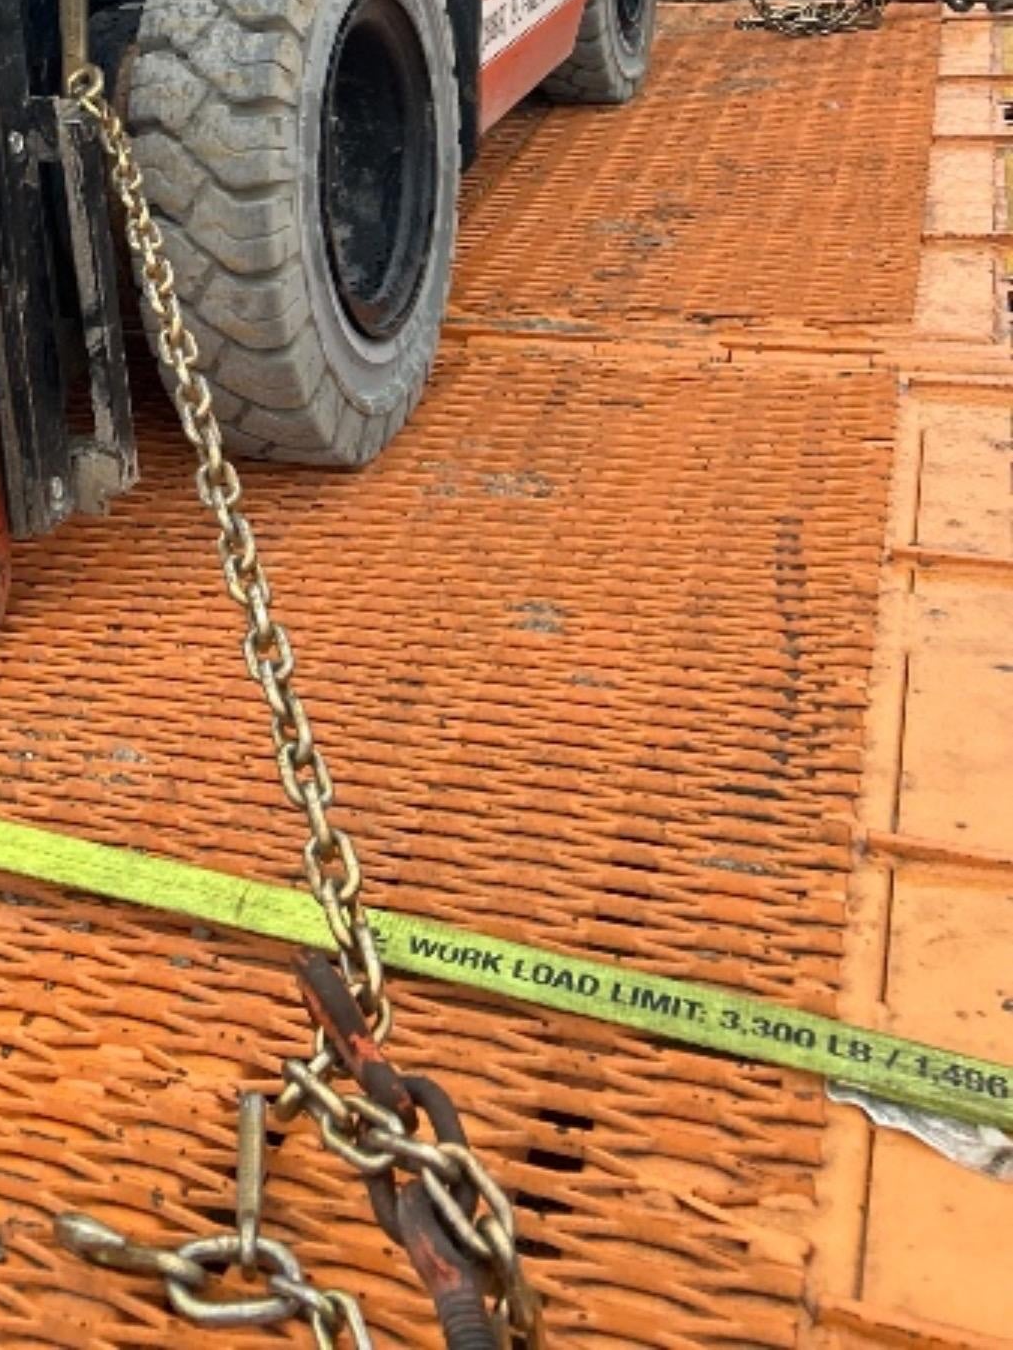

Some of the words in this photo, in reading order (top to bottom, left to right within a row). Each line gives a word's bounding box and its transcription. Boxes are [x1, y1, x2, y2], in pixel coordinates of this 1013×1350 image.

[409, 935, 505, 975] WORK
[512, 959, 600, 997] LOAD
[611, 981, 708, 1024] LIMIT:
[718, 1009, 816, 1049] 3,300
[827, 1033, 873, 1063] LB
